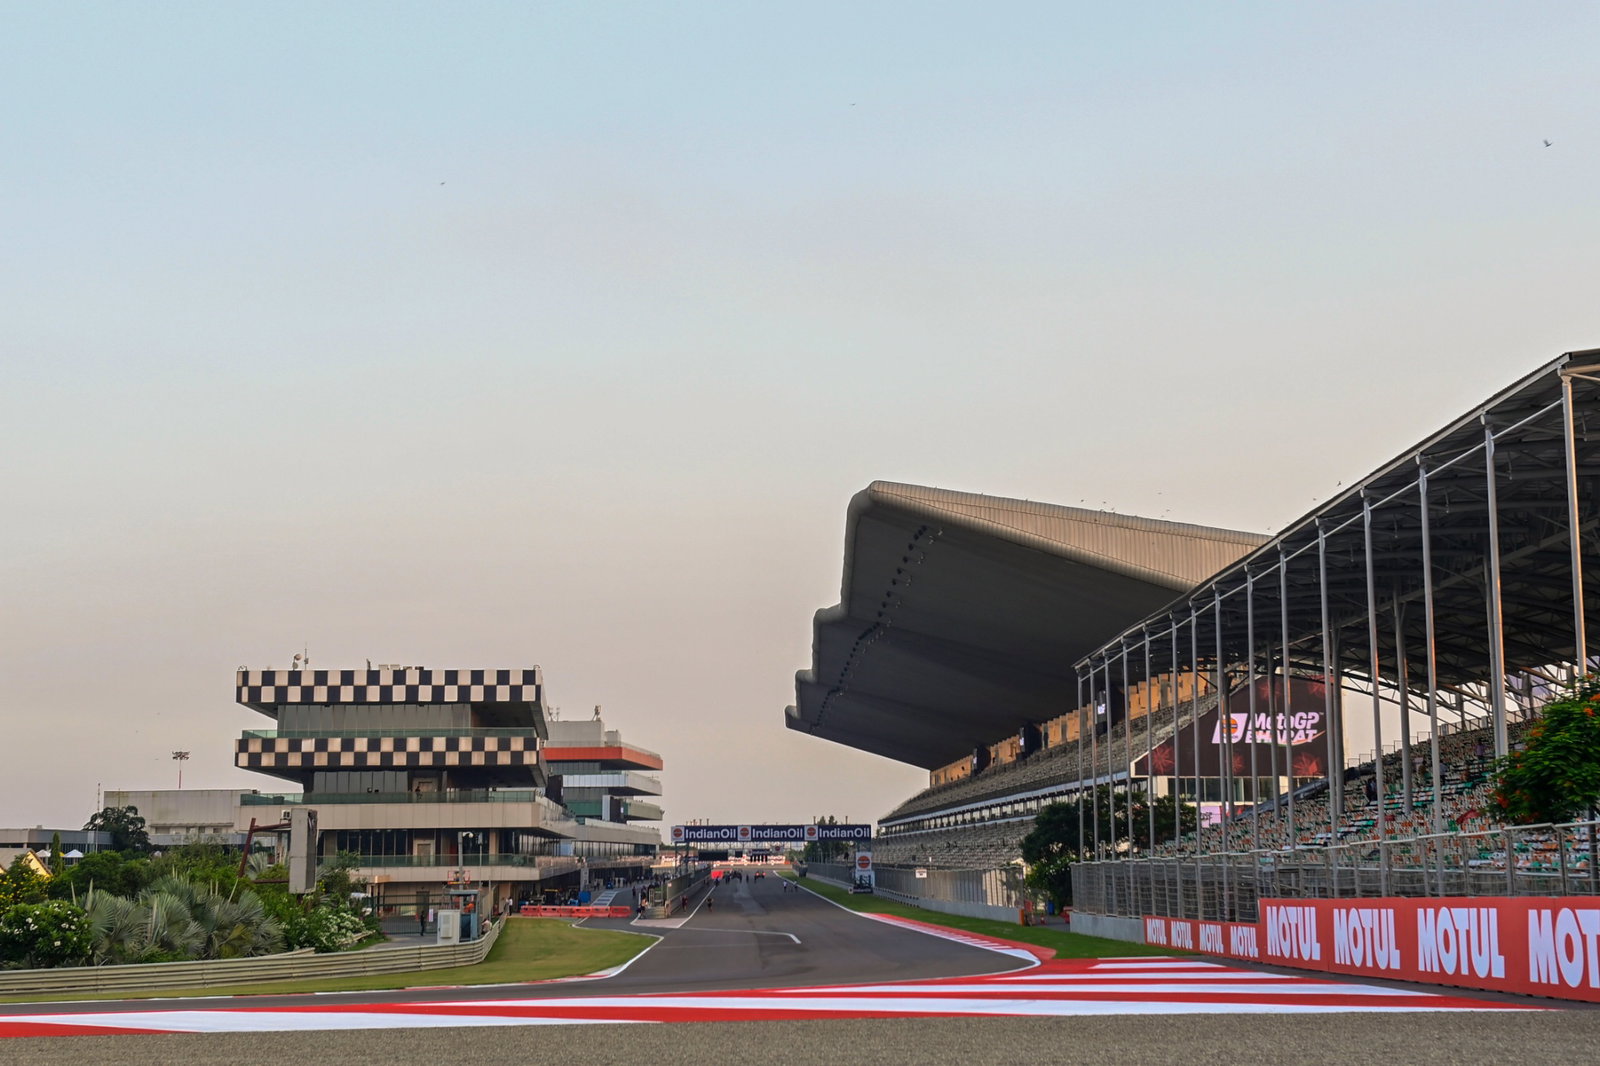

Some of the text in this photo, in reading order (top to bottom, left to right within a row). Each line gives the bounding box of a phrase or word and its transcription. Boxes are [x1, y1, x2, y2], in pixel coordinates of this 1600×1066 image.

[1248, 712, 1319, 730] MotoGP
[685, 828, 736, 839] IndianOil
[752, 828, 803, 839] IndianOil
[819, 827, 870, 838] IndianOil
[1146, 918, 1167, 945] MOTUL
[1171, 920, 1193, 949] MOTUL
[1199, 923, 1224, 954] MOTUL
[1230, 925, 1258, 958] MOTUL
[1266, 905, 1321, 961] MOTUL
[1333, 907, 1400, 970] MOTUL
[1417, 906, 1505, 979] MOTUL
